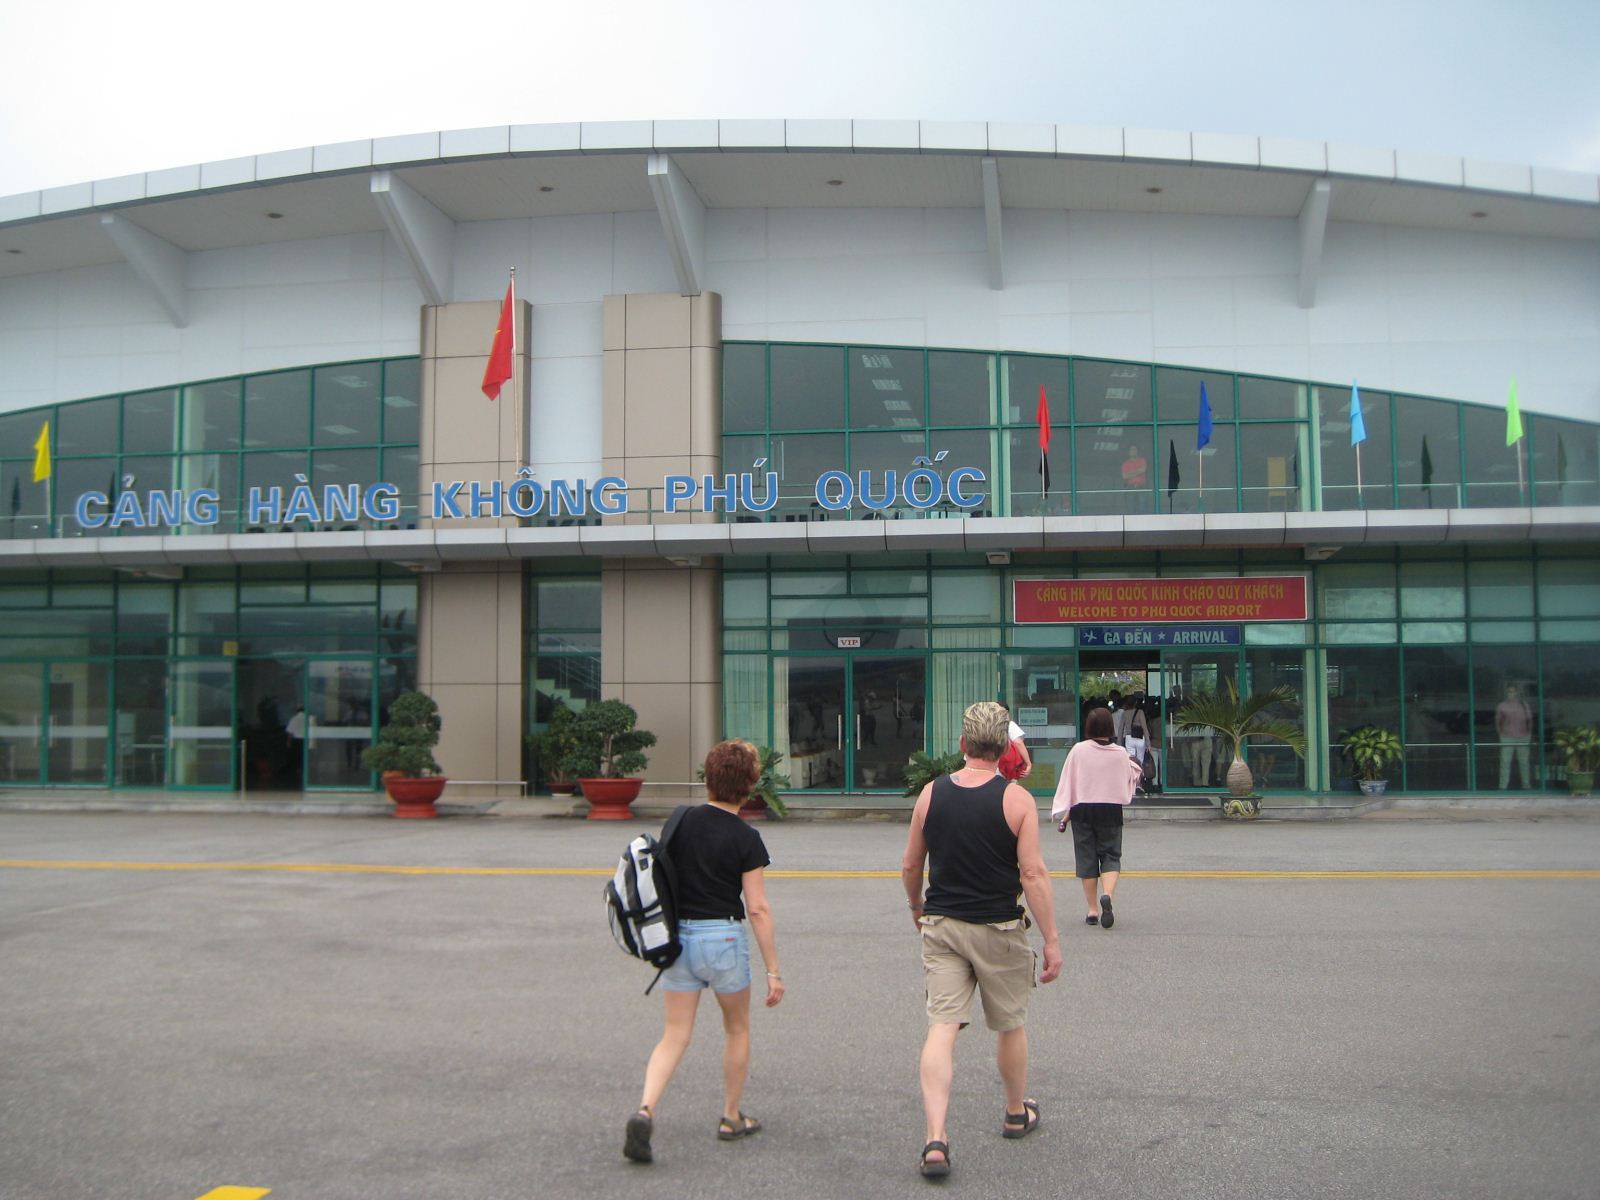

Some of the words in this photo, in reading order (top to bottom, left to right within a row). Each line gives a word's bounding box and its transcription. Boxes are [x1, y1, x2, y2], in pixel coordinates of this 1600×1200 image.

[76, 472, 220, 528] CẢNG
[249, 473, 399, 524] HÀNG
[431, 465, 628, 519] KHÔNG
[663, 457, 779, 513] PHÚ
[815, 450, 986, 511] QUỐC
[1070, 586, 1086, 602] HK
[1058, 606, 1118, 618] WELCOME
[1121, 606, 1138, 617] TO
[1141, 606, 1167, 617] PHU
[1170, 605, 1202, 617] QUOC
[1206, 604, 1262, 617] AIRPORT
[1103, 631, 1121, 645] GA
[1173, 630, 1228, 644] ARRIVAL
